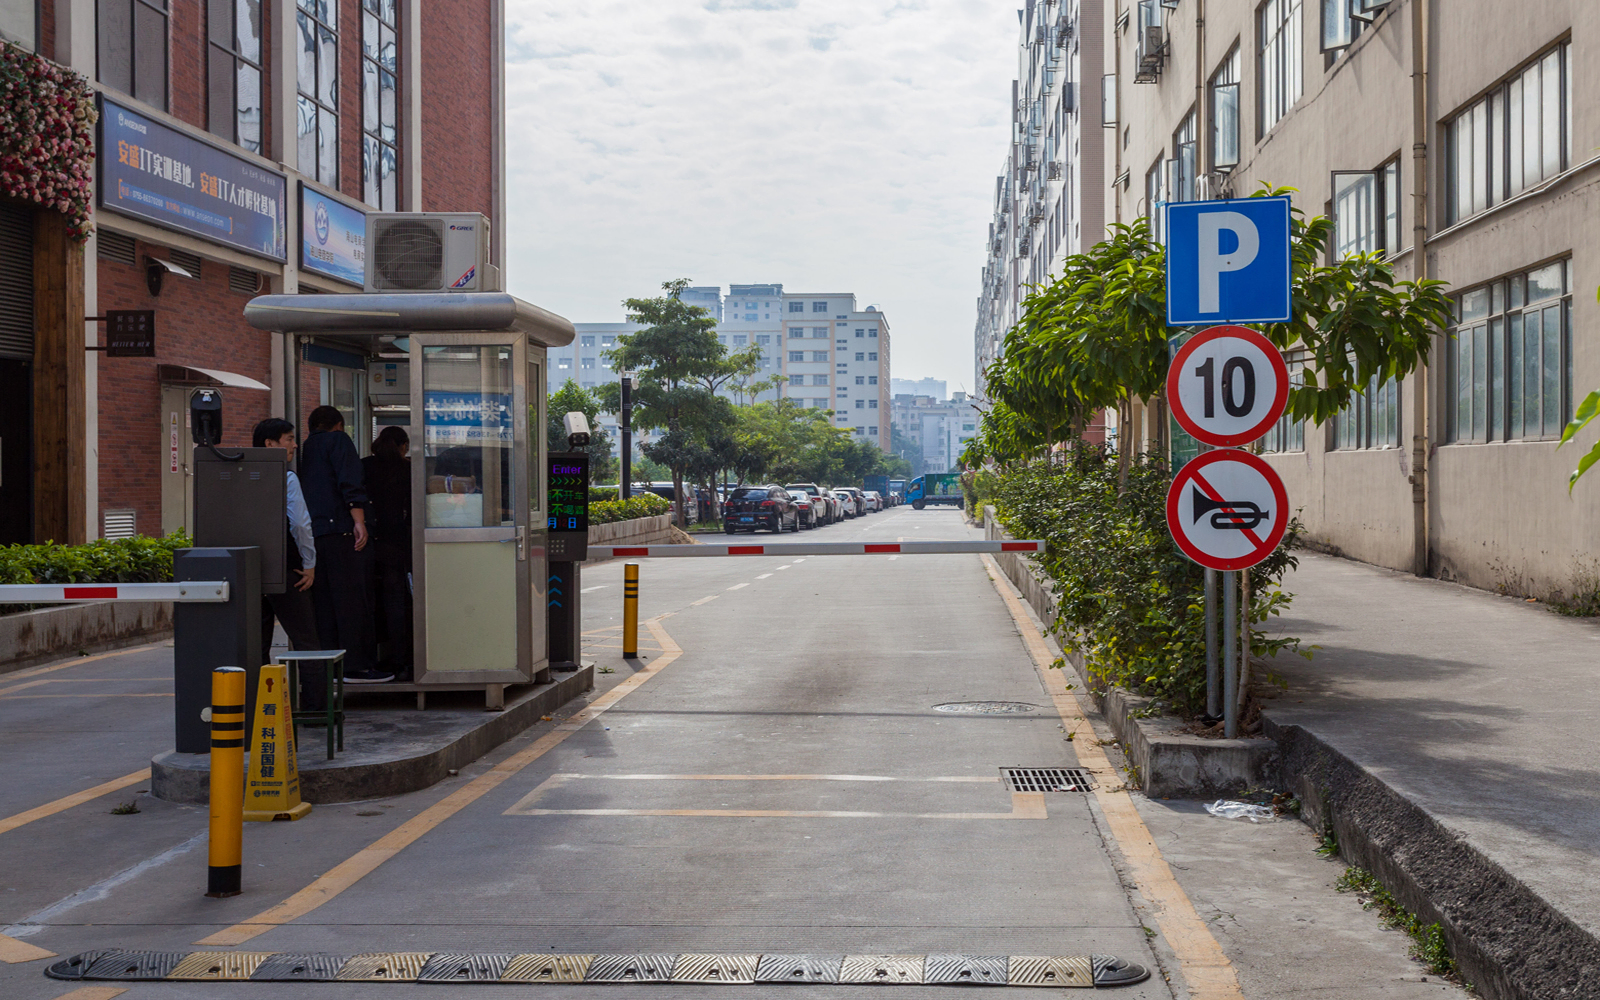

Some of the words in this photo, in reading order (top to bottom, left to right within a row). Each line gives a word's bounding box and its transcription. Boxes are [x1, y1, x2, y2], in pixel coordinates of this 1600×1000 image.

[1197, 211, 1260, 314] P
[1195, 356, 1256, 419] 10
[552, 464, 582, 475] Enter
[547, 503, 584, 516] 不喝酒
